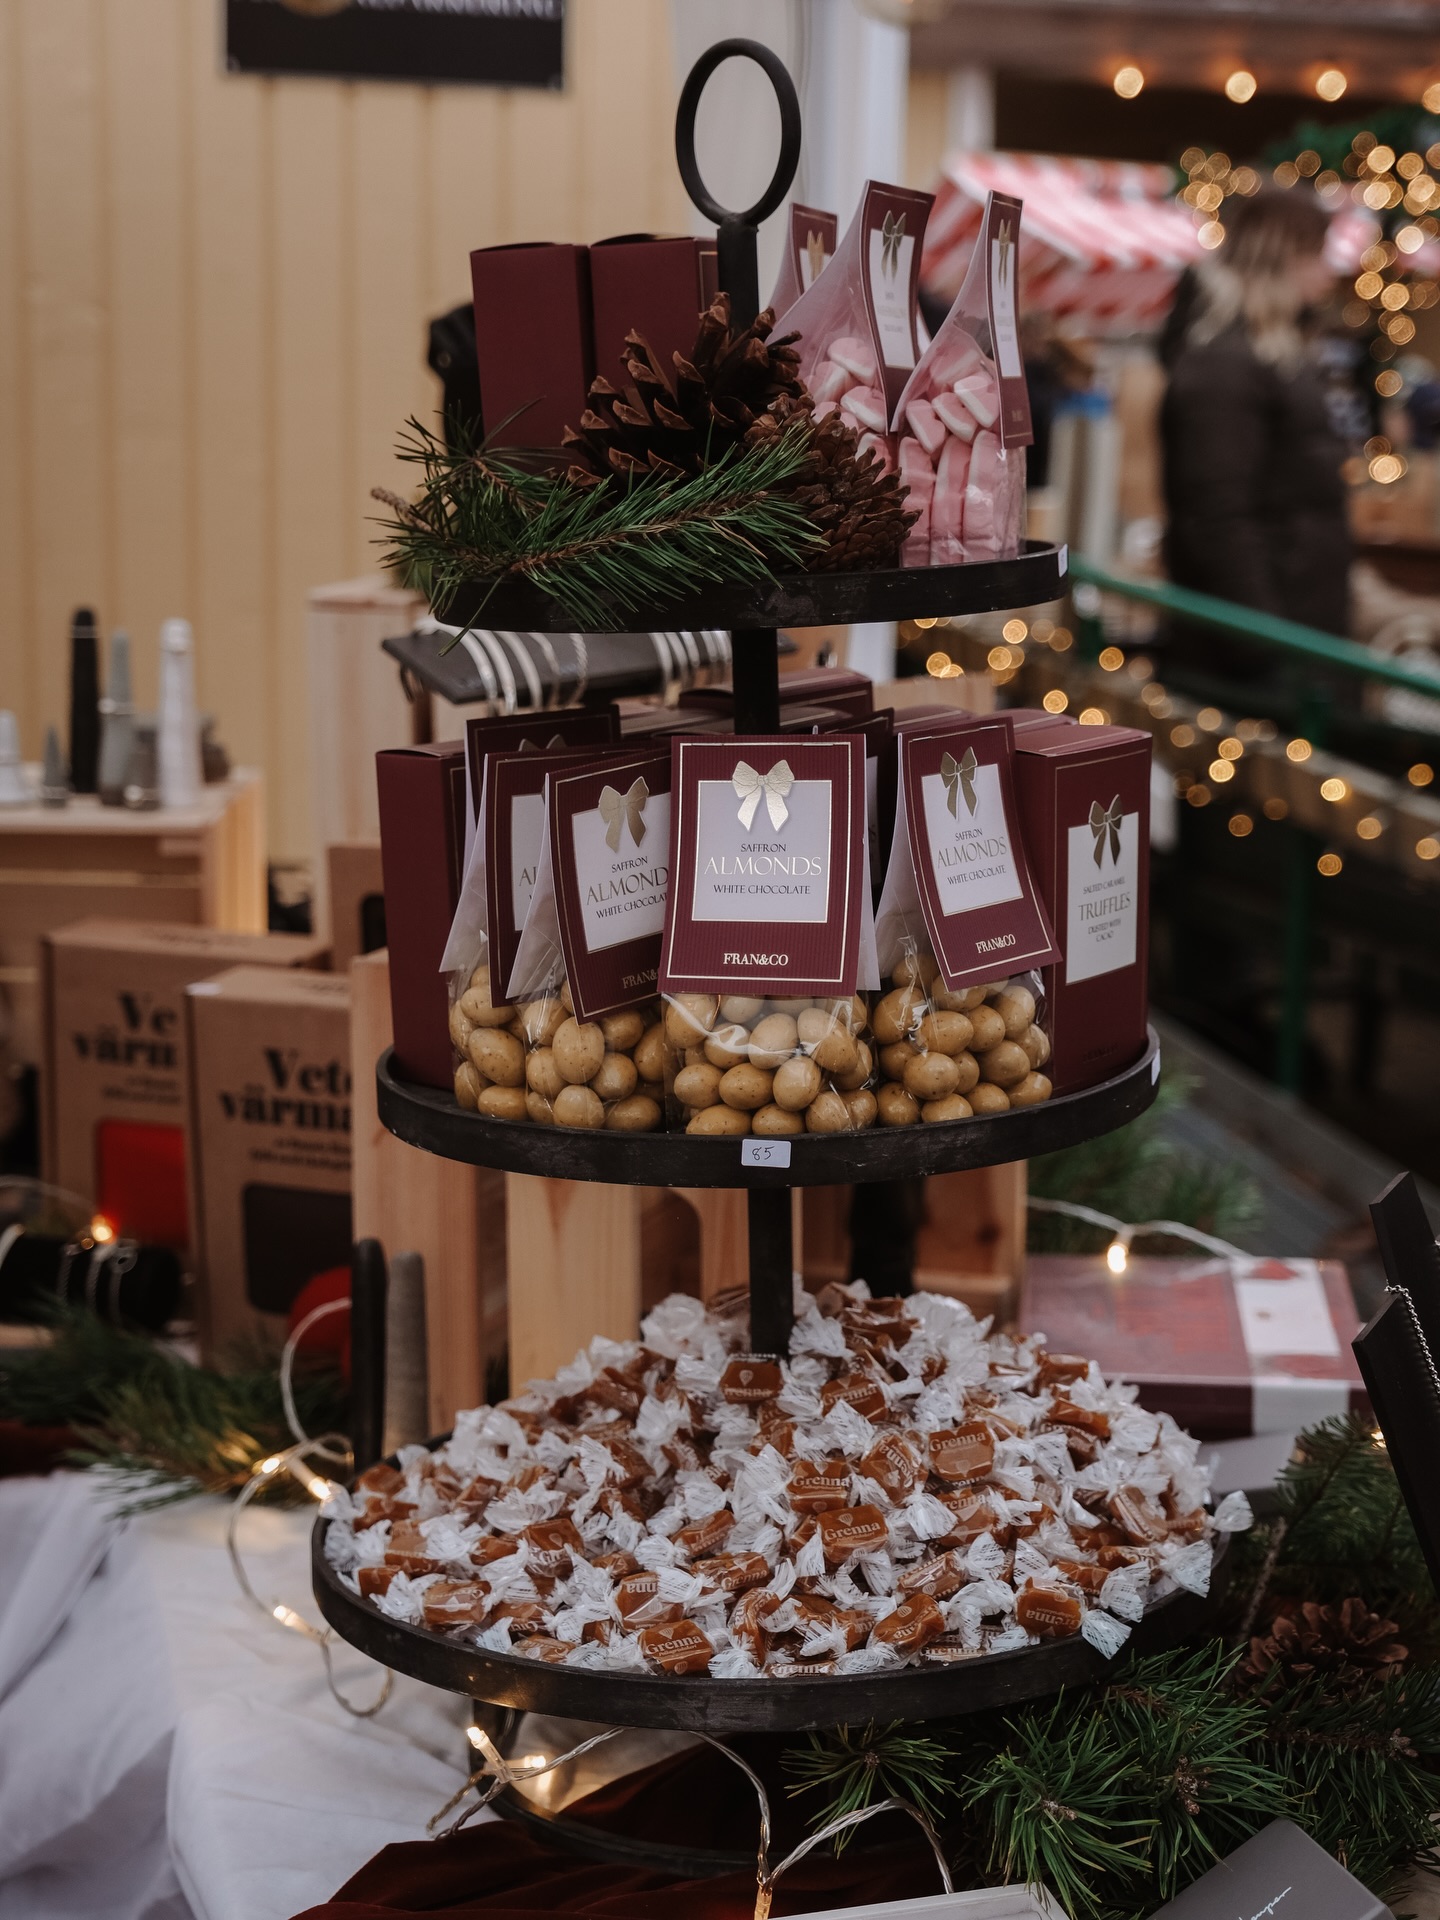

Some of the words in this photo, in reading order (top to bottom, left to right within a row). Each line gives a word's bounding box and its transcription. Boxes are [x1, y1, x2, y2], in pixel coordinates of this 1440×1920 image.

[955, 828, 983, 842] SAFFRON
[740, 843, 787, 853] SAFFRON
[937, 837, 1008, 869] ALMONDS
[611, 856, 648, 873] SAFFRON
[704, 856, 822, 876] ALMONDS
[946, 872, 969, 885] WHITE
[968, 864, 1007, 881] CHOCOLATE
[586, 866, 669, 906] ALMOND
[713, 884, 746, 894] WHITE
[748, 884, 811, 895] CHOCOLATE
[596, 904, 624, 919] WHITE
[624, 892, 668, 912] CHOCOLAT
[1078, 891, 1131, 921] TRUFFLES
[975, 933, 1016, 954] FRAN&CO
[723, 952, 789, 966] FRAN&CO
[622, 967, 659, 989] FRAN&
[752, 1146, 775, 1161] 85
[929, 1432, 987, 1452] Grenna
[792, 1475, 850, 1487] Grenna
[943, 1494, 987, 1510] renna
[824, 1522, 881, 1543] Grenna
[1026, 1608, 1081, 1631] Grenna
[645, 1634, 703, 1655] Grenna
